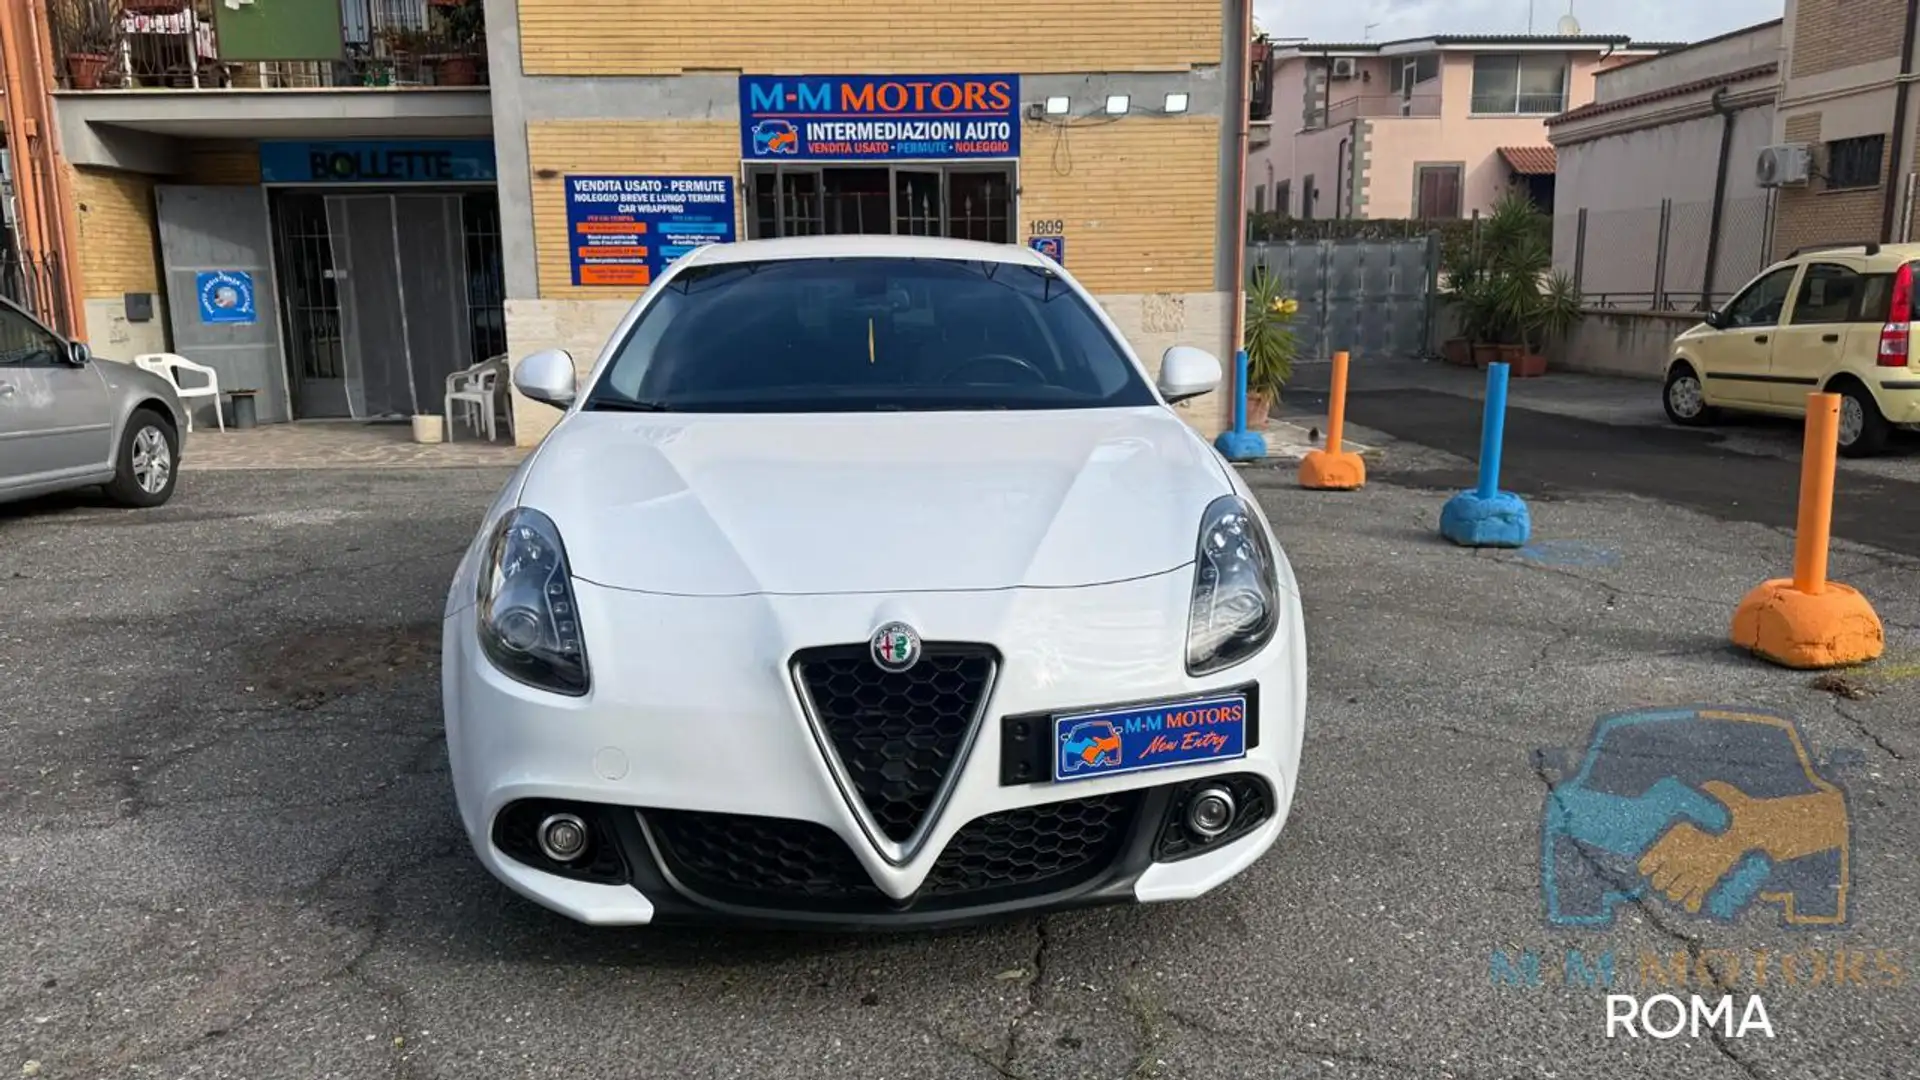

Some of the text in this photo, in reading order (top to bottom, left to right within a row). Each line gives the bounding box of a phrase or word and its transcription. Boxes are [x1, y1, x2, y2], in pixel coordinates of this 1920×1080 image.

[750, 81, 1011, 112] M-M MOTORS
[806, 121, 1011, 141] INTERMEDIAZIONI AUTO
[807, 141, 1010, 154] VENDITA USATO PERMUTE NOLEGGIO
[310, 151, 453, 179] BOLLETTE
[574, 180, 622, 192] VENDITA
[624, 180, 662, 192] USATO
[671, 180, 726, 192] PERMUTE
[574, 193, 726, 203] NOLEGGIO BREVE E LUNGO TERMINE
[618, 204, 684, 213] CAR WRAPPING
[1030, 219, 1064, 235] 1809
[1165, 705, 1242, 729] MOTORS
[1139, 731, 1229, 759] New Entry
